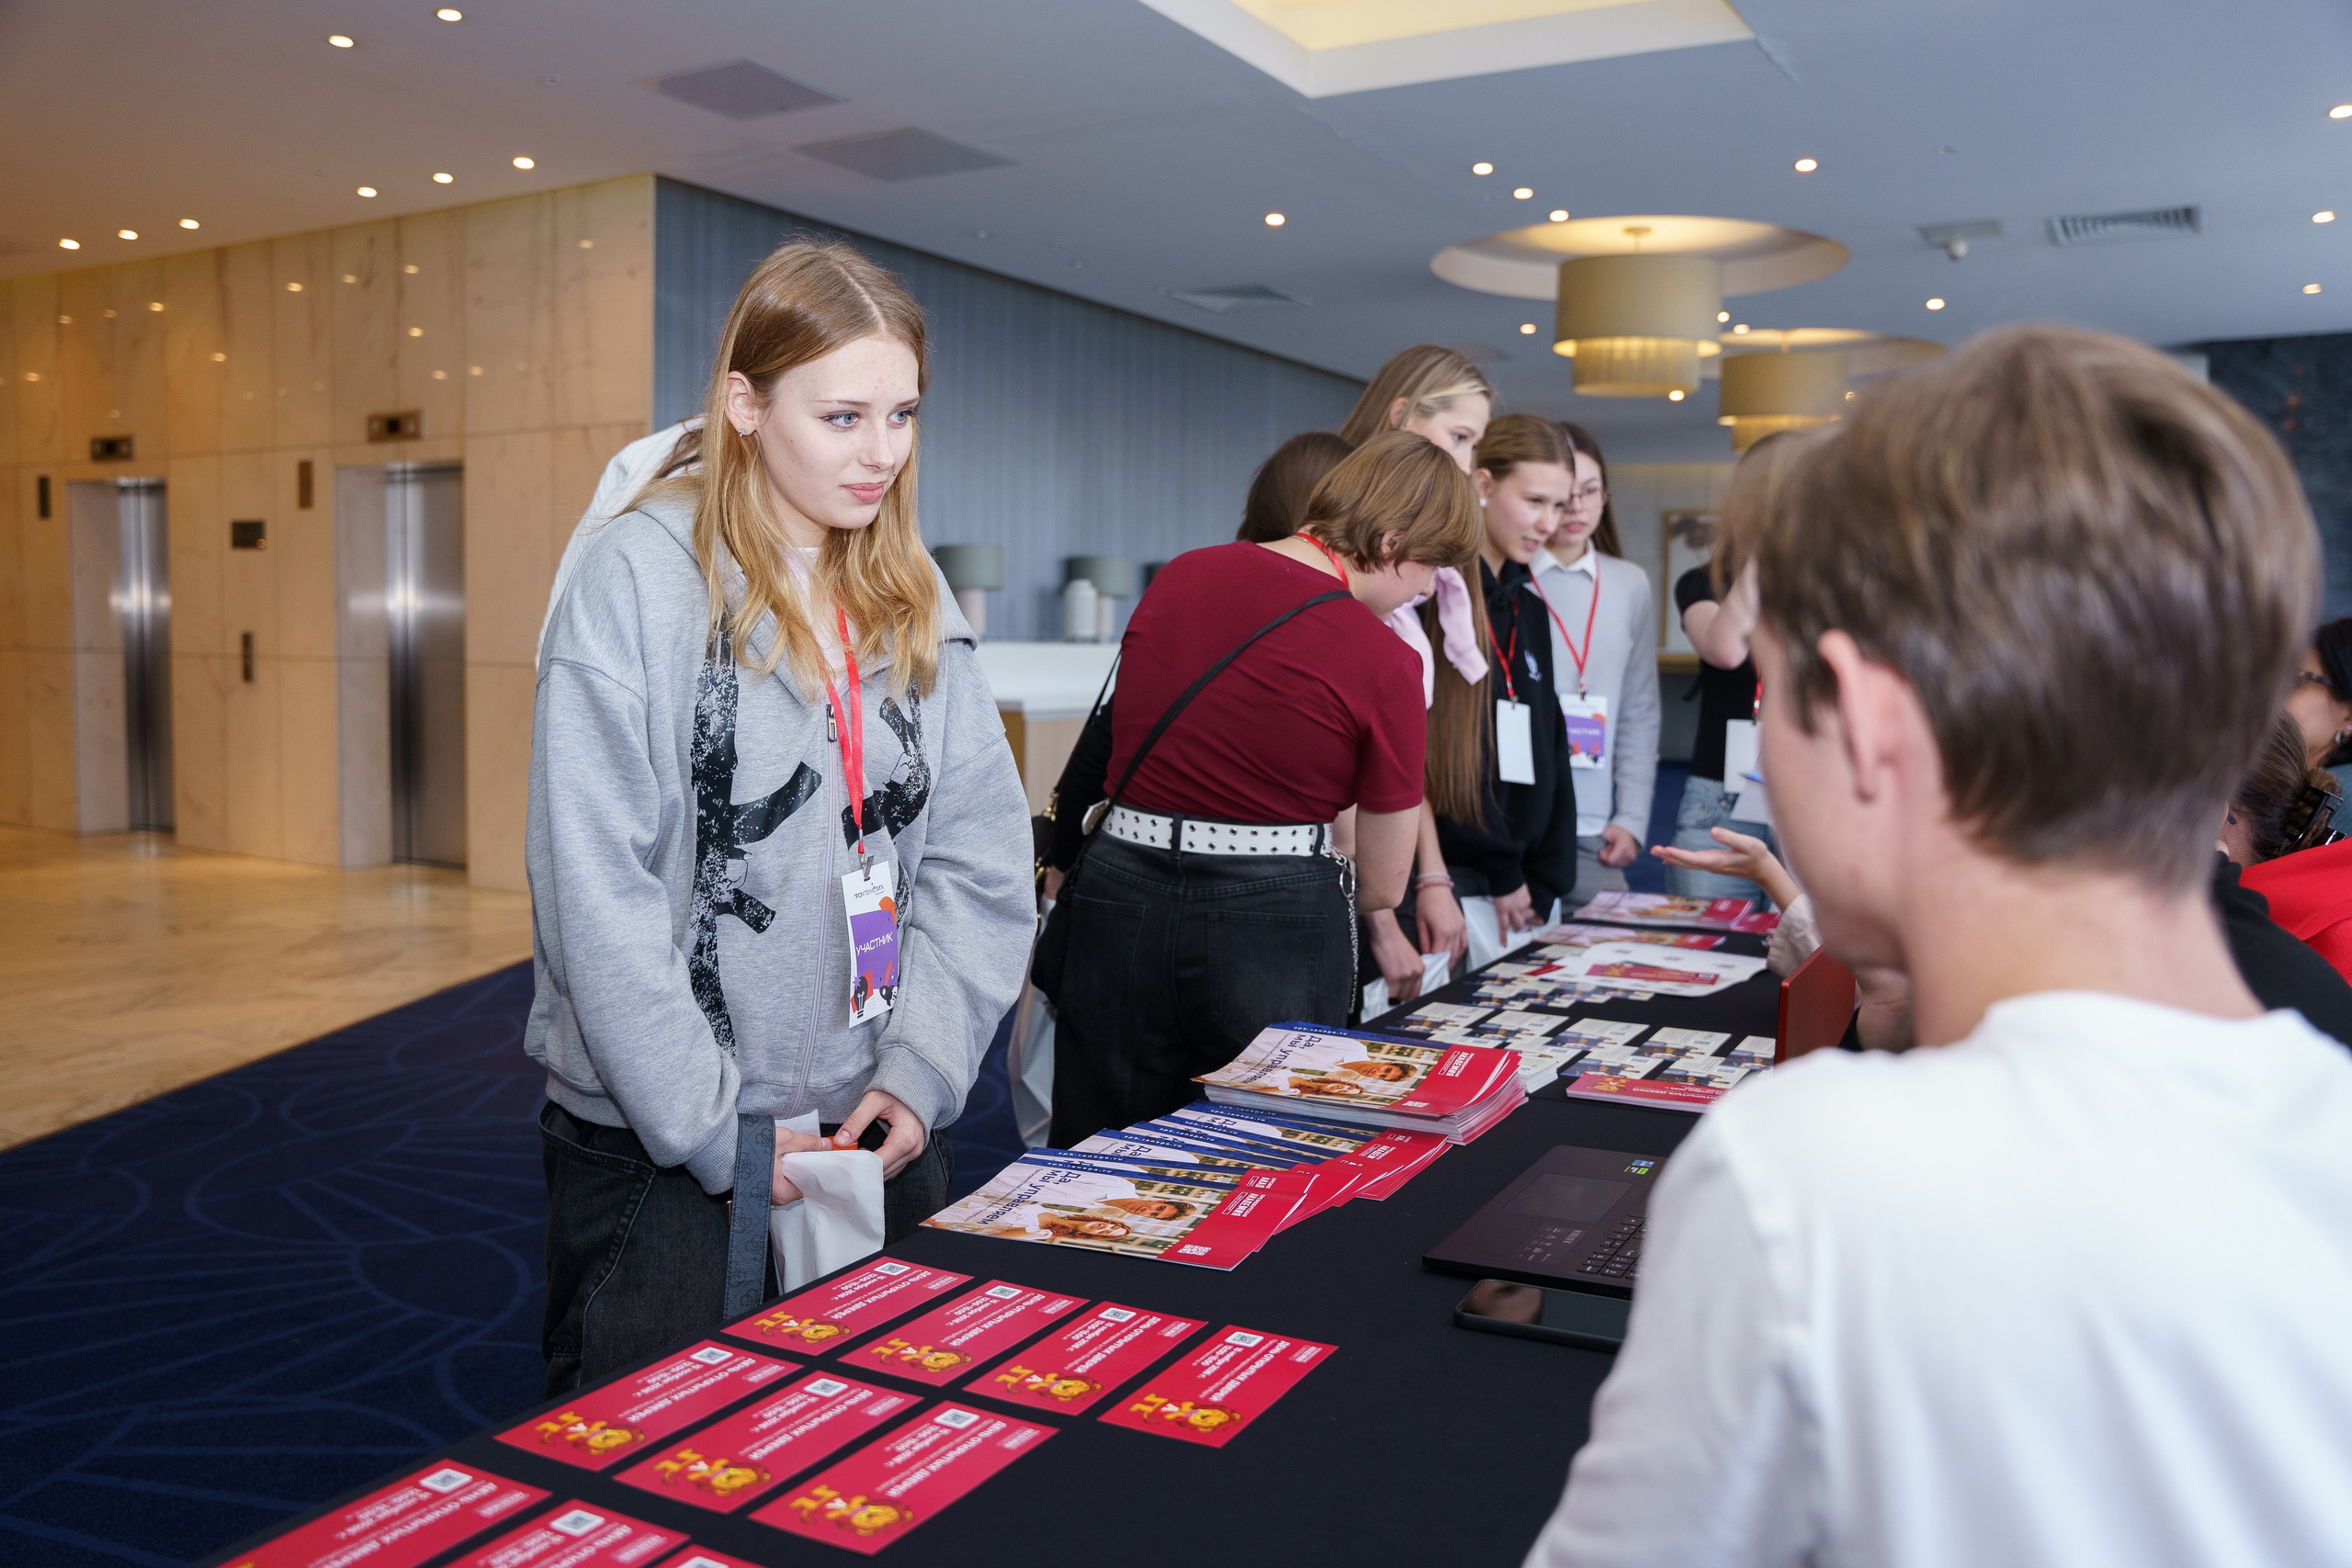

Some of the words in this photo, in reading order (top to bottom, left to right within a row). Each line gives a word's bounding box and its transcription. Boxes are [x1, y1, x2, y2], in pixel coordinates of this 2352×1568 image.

[855, 932, 894, 956] УЧАСТНИК
[1287, 1034, 1306, 1047] мы
[1299, 1035, 1322, 1049] Да,
[1242, 1048, 1293, 1085] управляем
[1445, 1051, 1470, 1077] АКАДЕМИЯ
[1124, 1135, 1182, 1148] spb.ranepa.ru
[1129, 1145, 1152, 1156] Да
[1058, 1152, 1124, 1161] spb.ranepa.ru
[1039, 1169, 1062, 1182] мы
[1047, 1161, 1112, 1174] spb.ranepa.ru
[1053, 1171, 1081, 1184] Да,
[977, 1183, 1045, 1225] управляем
[1231, 1192, 1260, 1217] АКАДЕМИЯ
[906, 1270, 933, 1281] ДЕНЬ
[863, 1280, 911, 1303] ОТКРЫТЫХ
[1020, 1293, 1046, 1305] ДЕНЬ
[829, 1302, 869, 1319] ДВЕРЕЙ
[979, 1304, 1026, 1327] ОТКРЫТЫХ
[1137, 1316, 1161, 1328] ДЕНЬ
[946, 1327, 987, 1346] ДВЕРЕЙ
[1101, 1328, 1144, 1353] ОТКРЫТЫХ
[1267, 1340, 1290, 1353] ДЕНЬ
[725, 1358, 757, 1371] ДЕНЬ
[1071, 1352, 1109, 1372] ДВЕРЕЙ
[1234, 1353, 1274, 1380] ОТКРЫТЫХ
[669, 1371, 729, 1399] ОТКРЫТЫХ
[1206, 1380, 1243, 1401] ДВЕРЕЙ
[842, 1390, 874, 1404] ДЕНЬ
[625, 1398, 675, 1421] ДВЕРЕЙ
[788, 1404, 848, 1435] ОТКРЫТЫХ
[976, 1421, 1007, 1437] ДЕНЬ
[745, 1434, 797, 1460] ДВЕРЕЙ
[924, 1436, 983, 1470] ОТКРЫТЫХ
[884, 1469, 933, 1496] ДВЕРЕЙ
